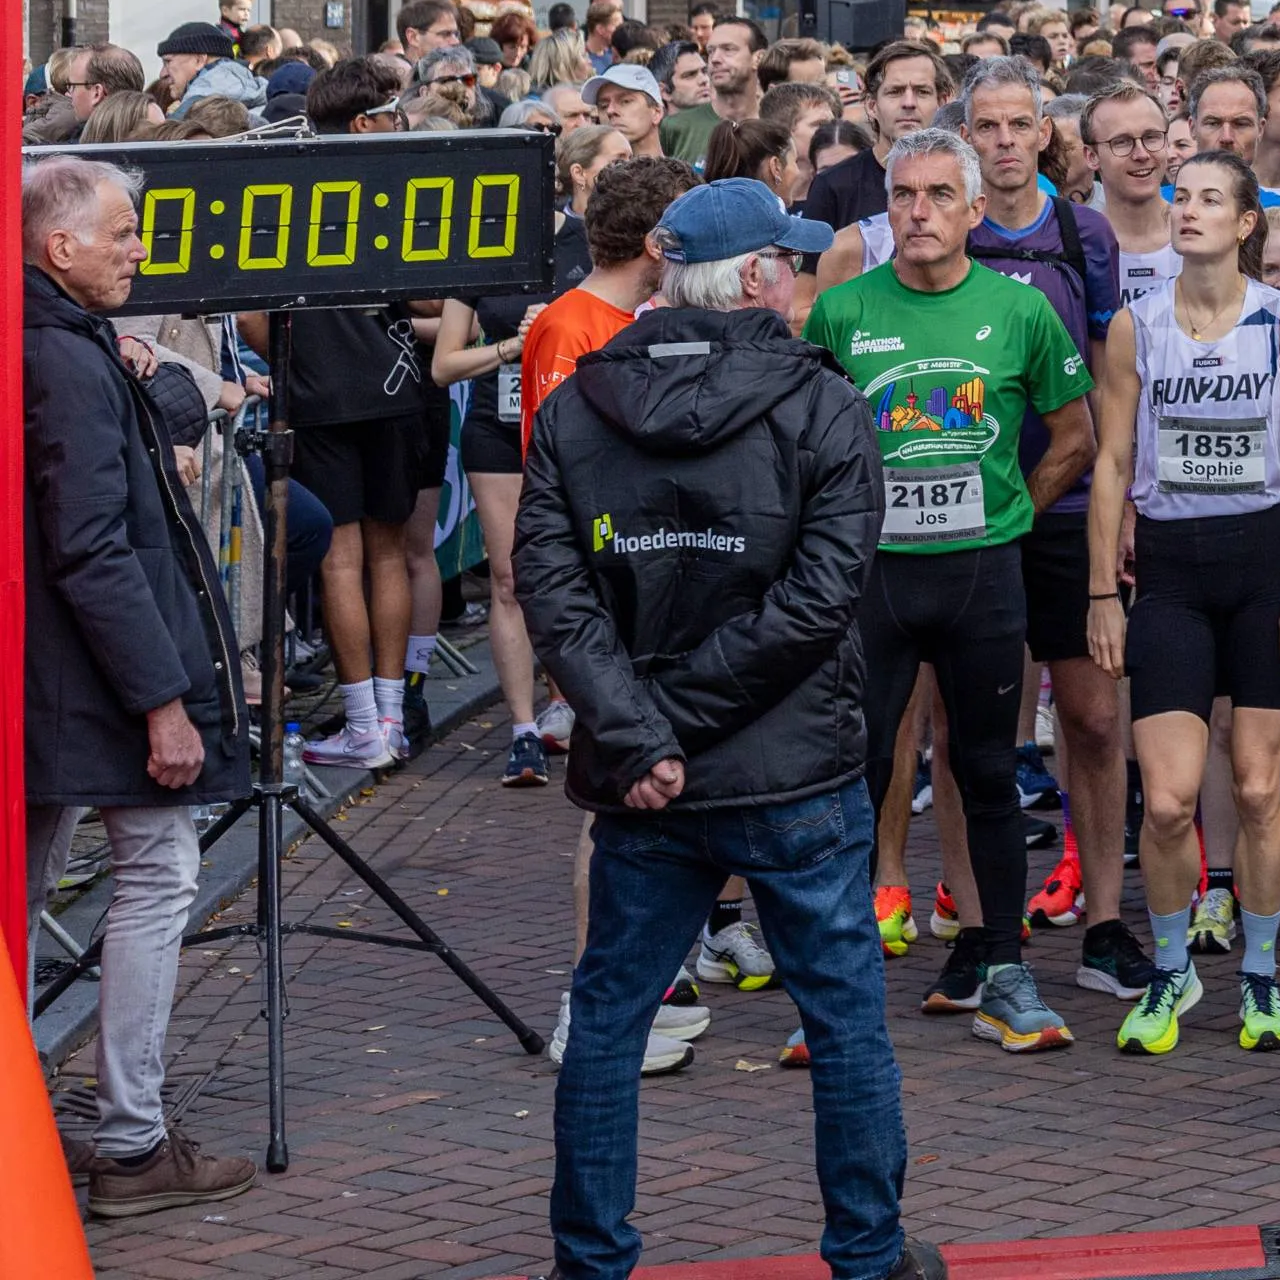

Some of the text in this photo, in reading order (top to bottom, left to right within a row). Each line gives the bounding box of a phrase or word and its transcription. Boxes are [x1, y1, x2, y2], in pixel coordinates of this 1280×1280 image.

[851, 336, 901, 350] MARATHON
[851, 342, 905, 356] ROTTERDAM
[1196, 357, 1219, 366] FUSION
[1153, 373, 1270, 406] RUN2DAY
[1175, 433, 1251, 457] 1853
[1182, 460, 1244, 478] Sophie
[891, 481, 967, 508] 2187
[915, 511, 948, 526] Jos
[614, 527, 745, 554] hoedemakers
